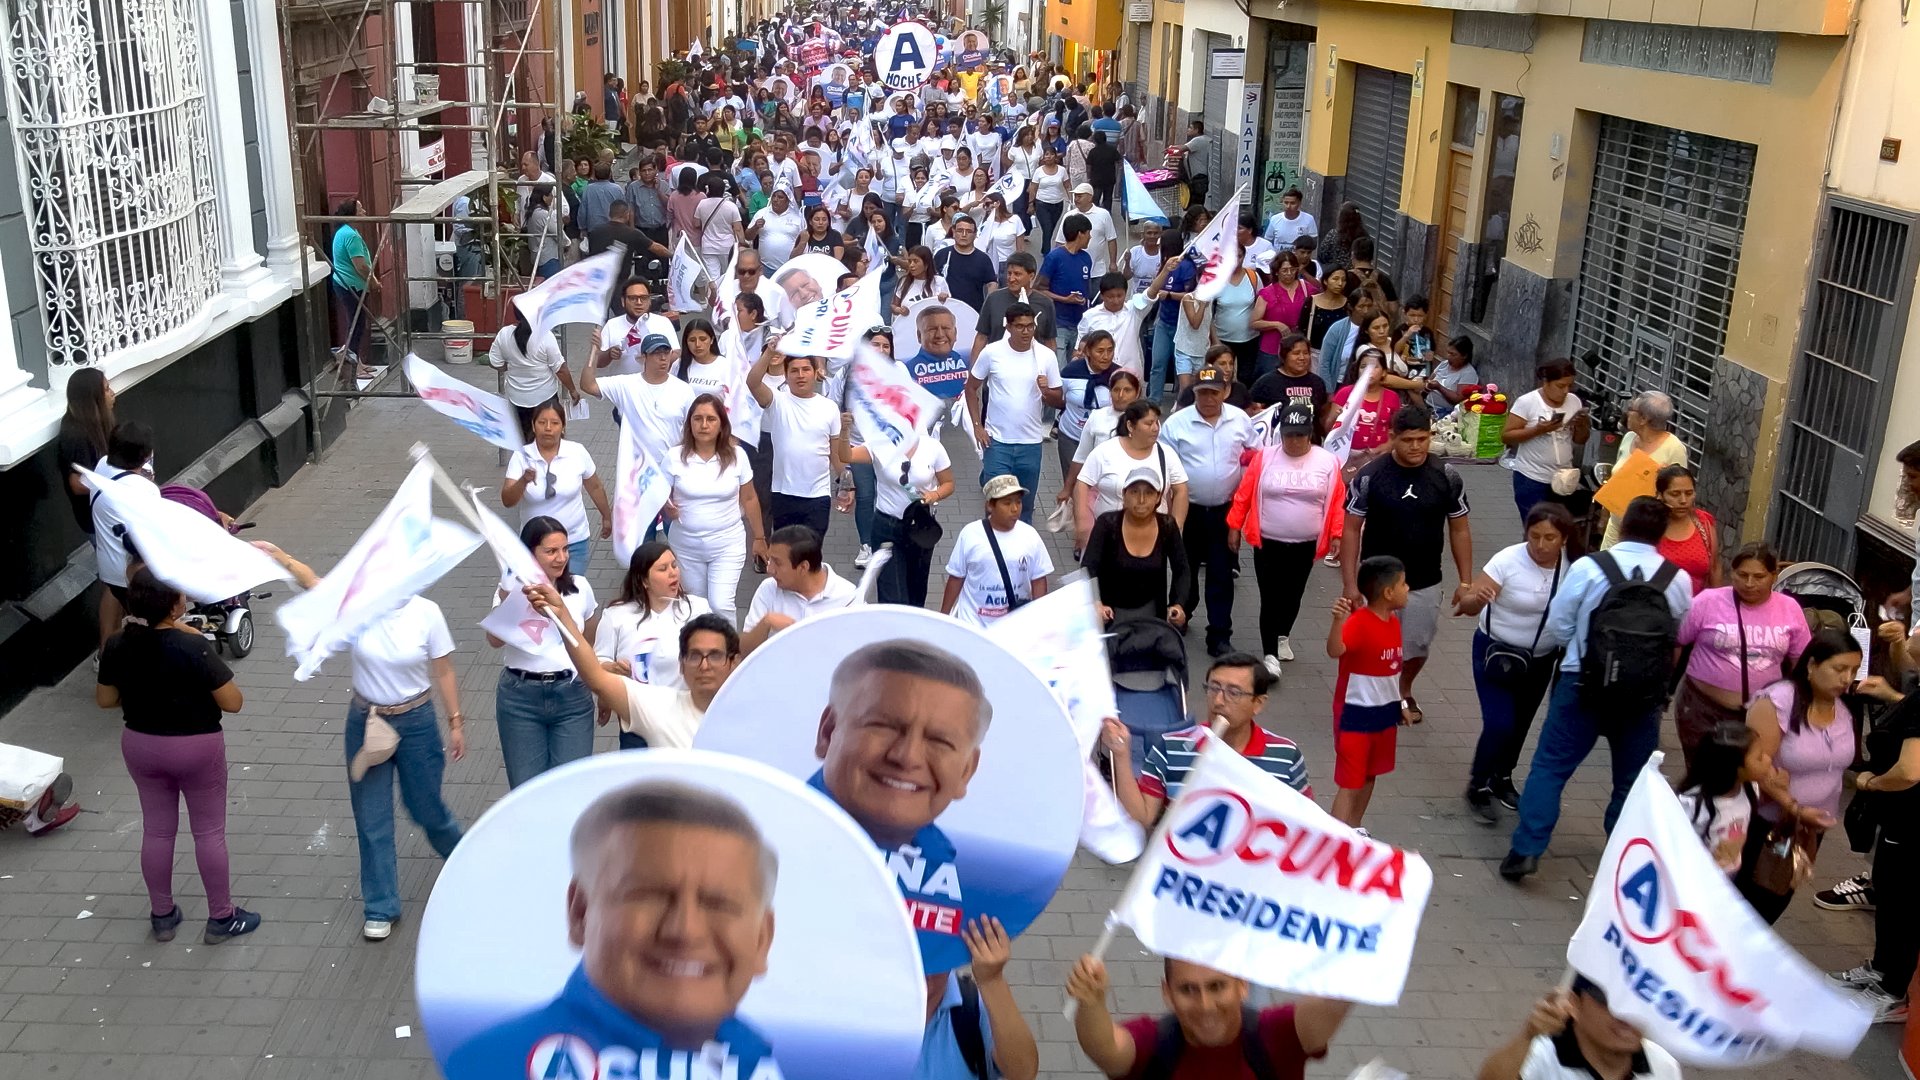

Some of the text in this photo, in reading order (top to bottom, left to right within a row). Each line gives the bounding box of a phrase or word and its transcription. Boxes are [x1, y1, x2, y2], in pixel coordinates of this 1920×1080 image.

[889, 32, 926, 71] A
[886, 72, 922, 88] MOCHE
[1240, 113, 1254, 177] LATAM
[914, 357, 966, 376] ACUÑA
[1200, 369, 1216, 380] CAT
[1153, 865, 1382, 953] PRESIDENTE
